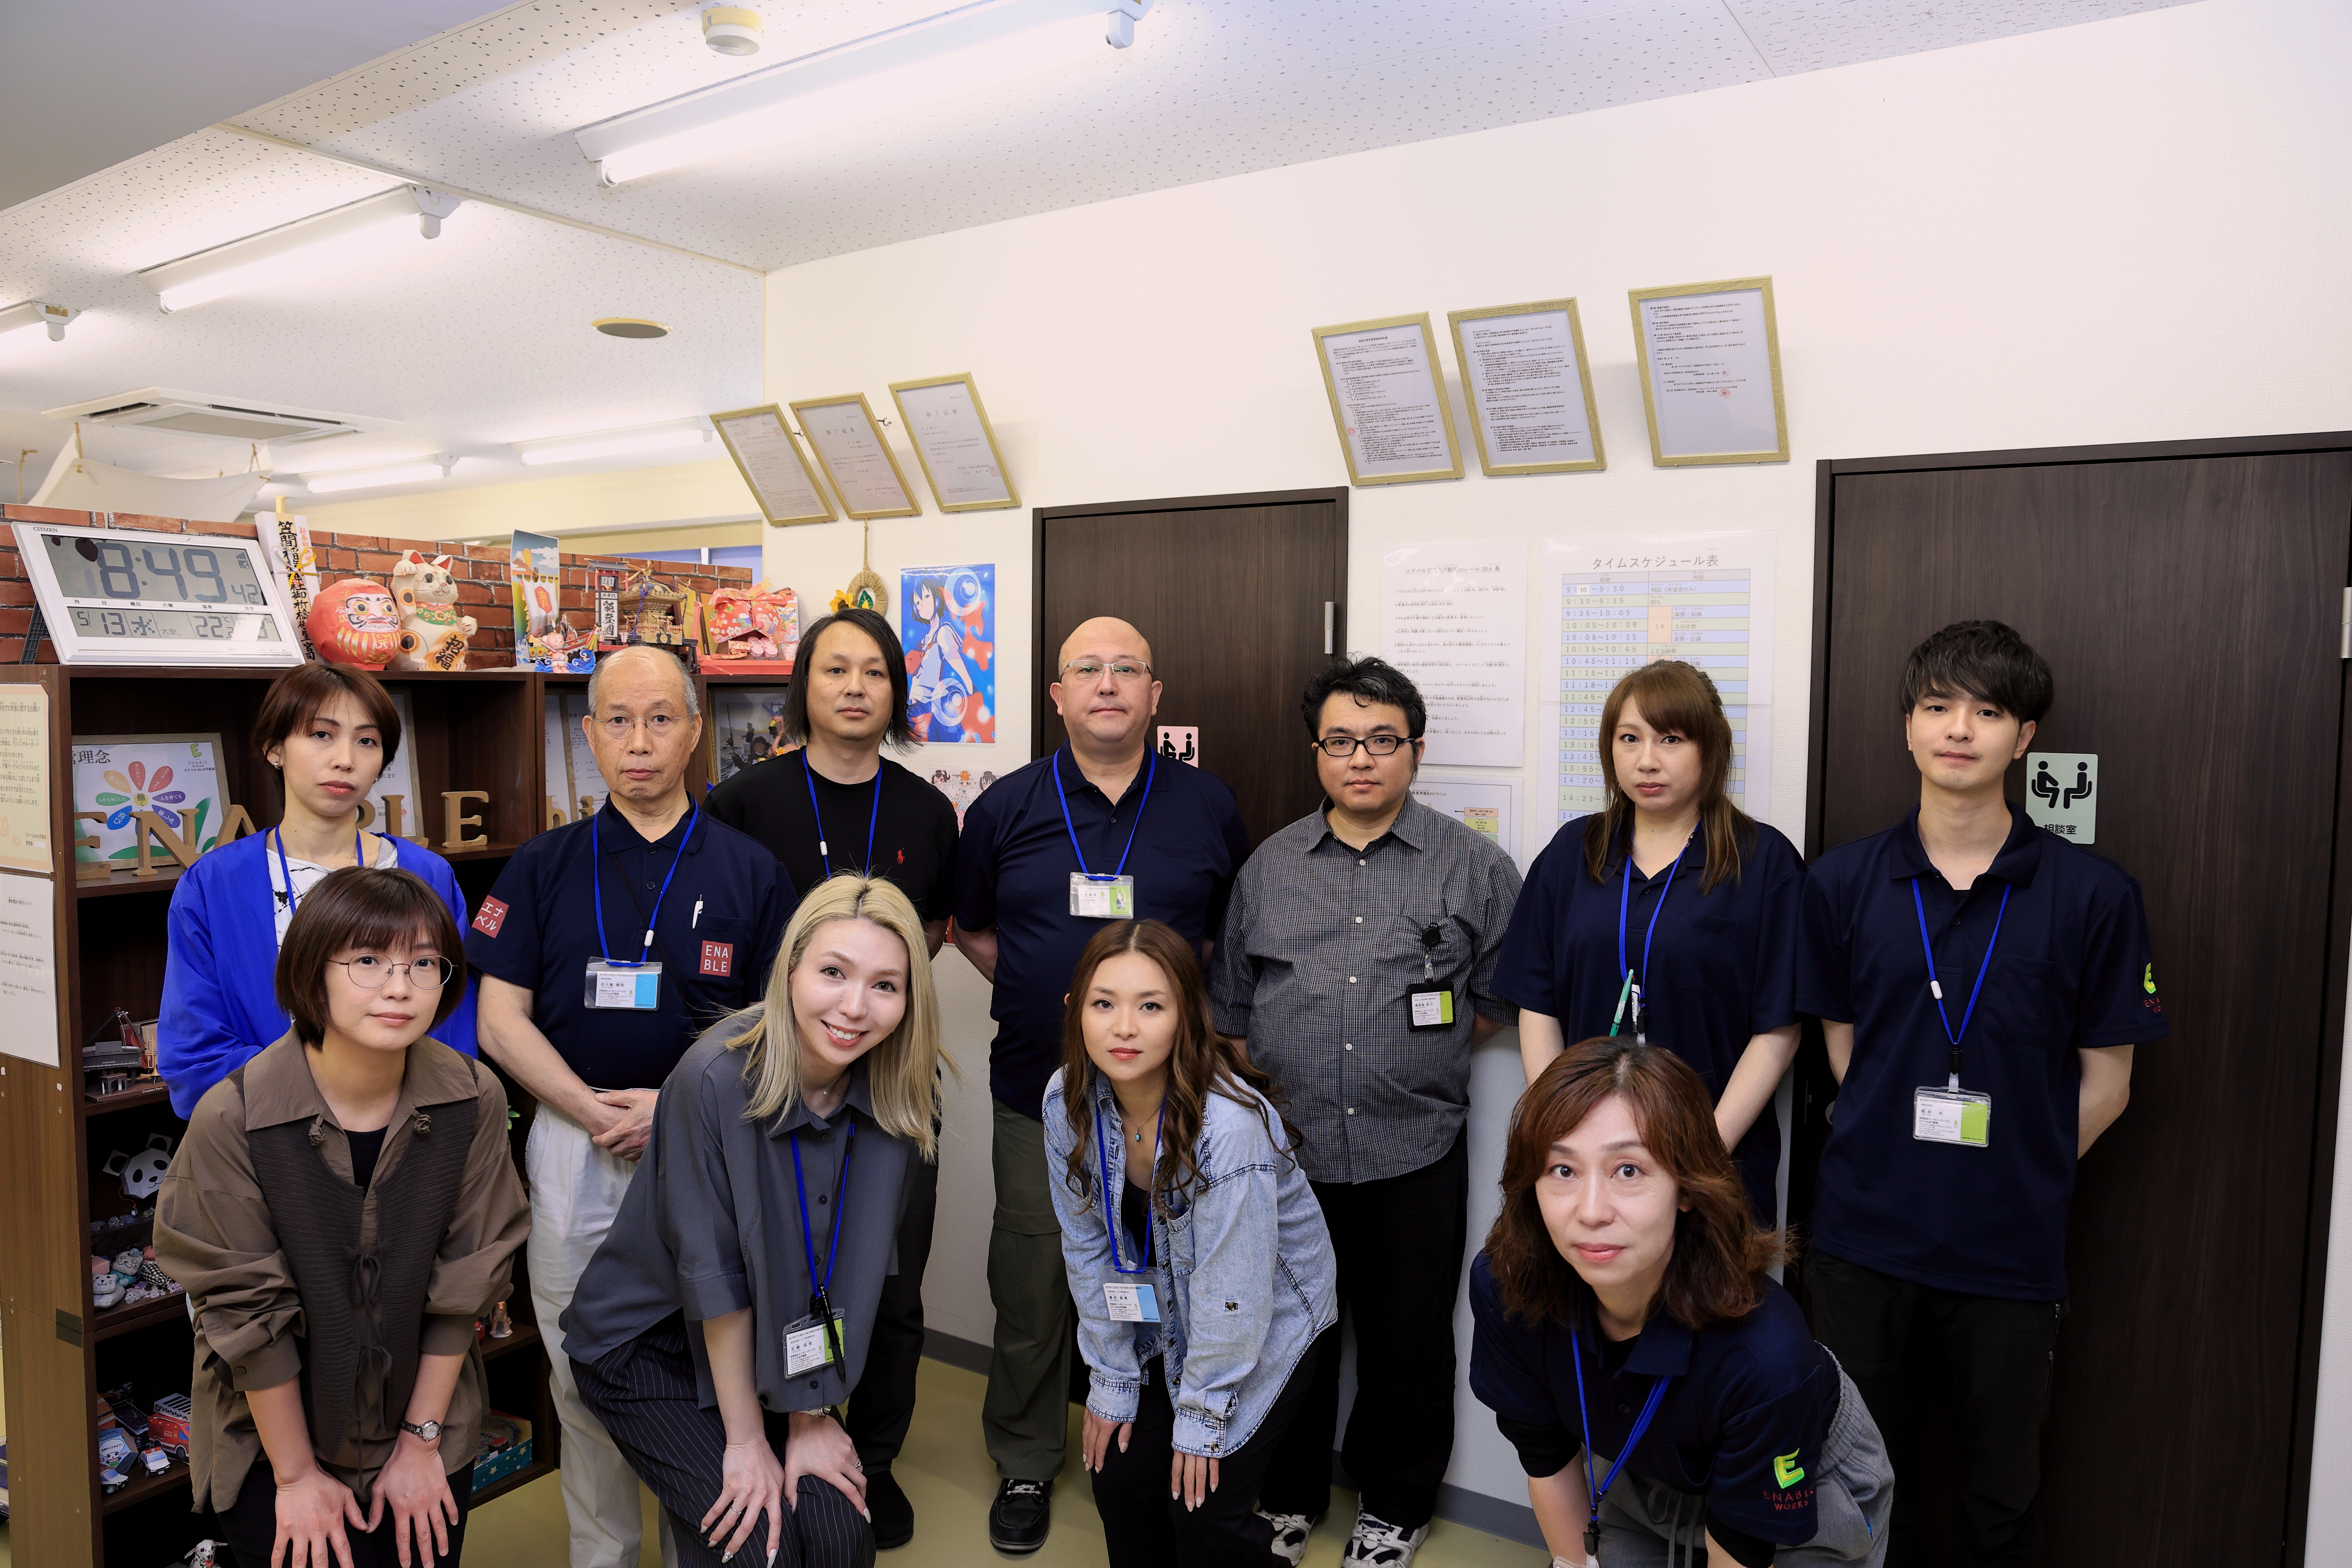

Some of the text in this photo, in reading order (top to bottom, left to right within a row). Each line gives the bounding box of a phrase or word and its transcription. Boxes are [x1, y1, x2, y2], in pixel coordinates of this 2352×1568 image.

[1593, 554, 1719, 570] タイムスケジュール表
[96, 543, 228, 603] 8:49
[231, 584, 260, 604] 42
[77, 611, 89, 626] 5
[101, 612, 126, 635] 13
[131, 616, 155, 636] 水
[435, 634, 465, 671] 招福
[137, 793, 145, 806] 働く
[157, 809, 175, 824] 楽しみ
[2043, 824, 2077, 835] 相談室
[481, 901, 504, 917] エナ
[475, 915, 497, 931] ベル
[705, 945, 729, 958] ENA
[704, 959, 728, 973] BLE
[1764, 1485, 1815, 1502] ENABLE
[1774, 1500, 1808, 1511] WORKS
